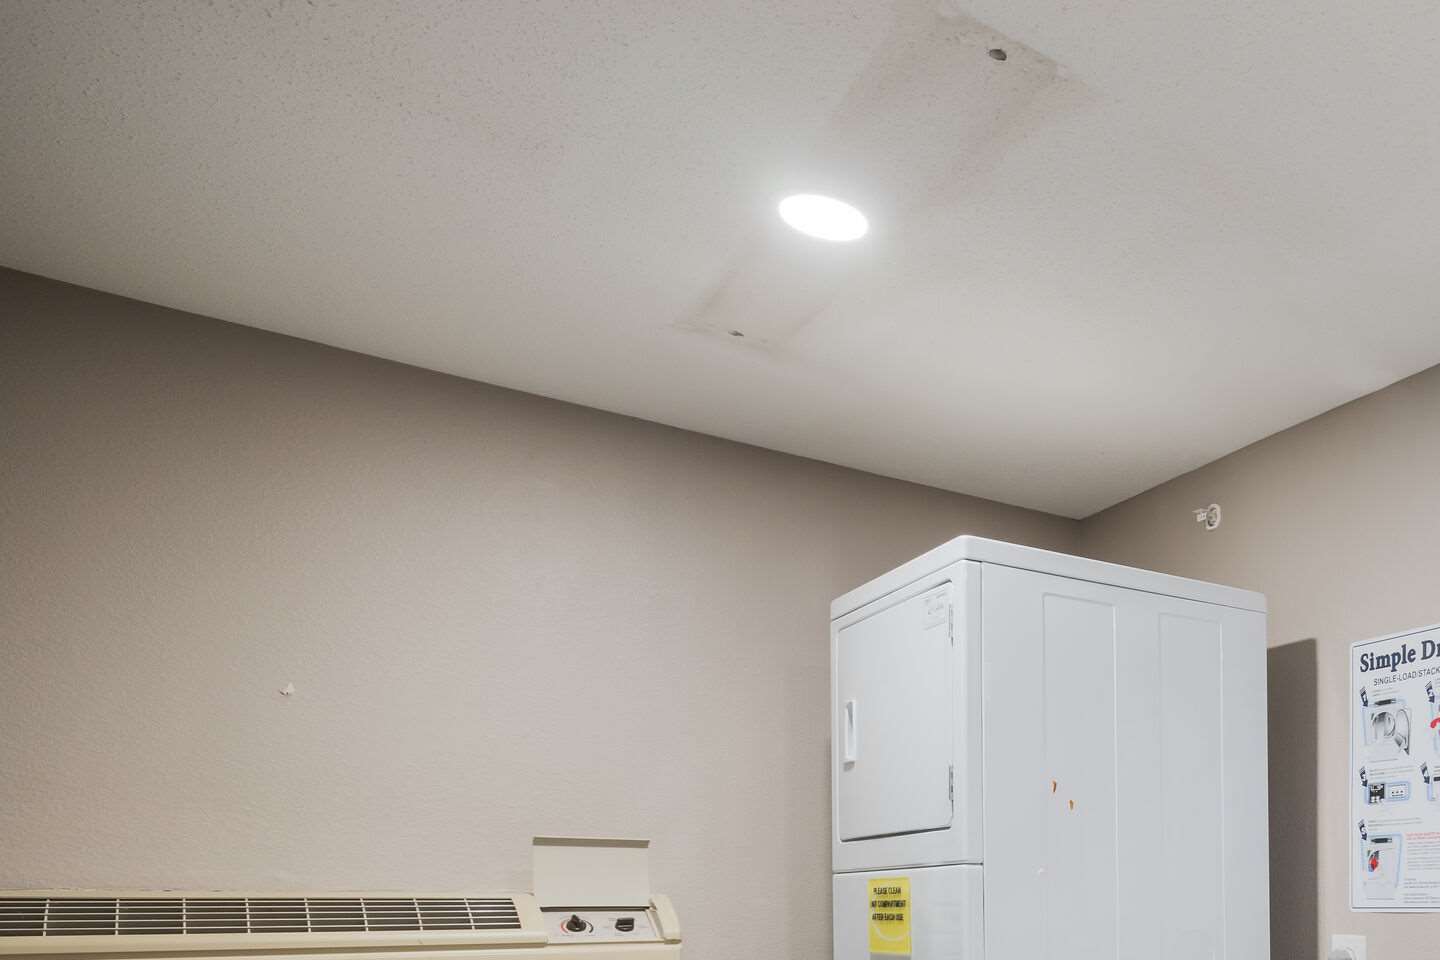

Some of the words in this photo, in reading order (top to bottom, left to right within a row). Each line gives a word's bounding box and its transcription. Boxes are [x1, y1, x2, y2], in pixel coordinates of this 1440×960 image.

[1360, 644, 1416, 673] Simple
[1373, 669, 1417, 687] SINGLE-LOAD
[1418, 666, 1440, 680] STACK
